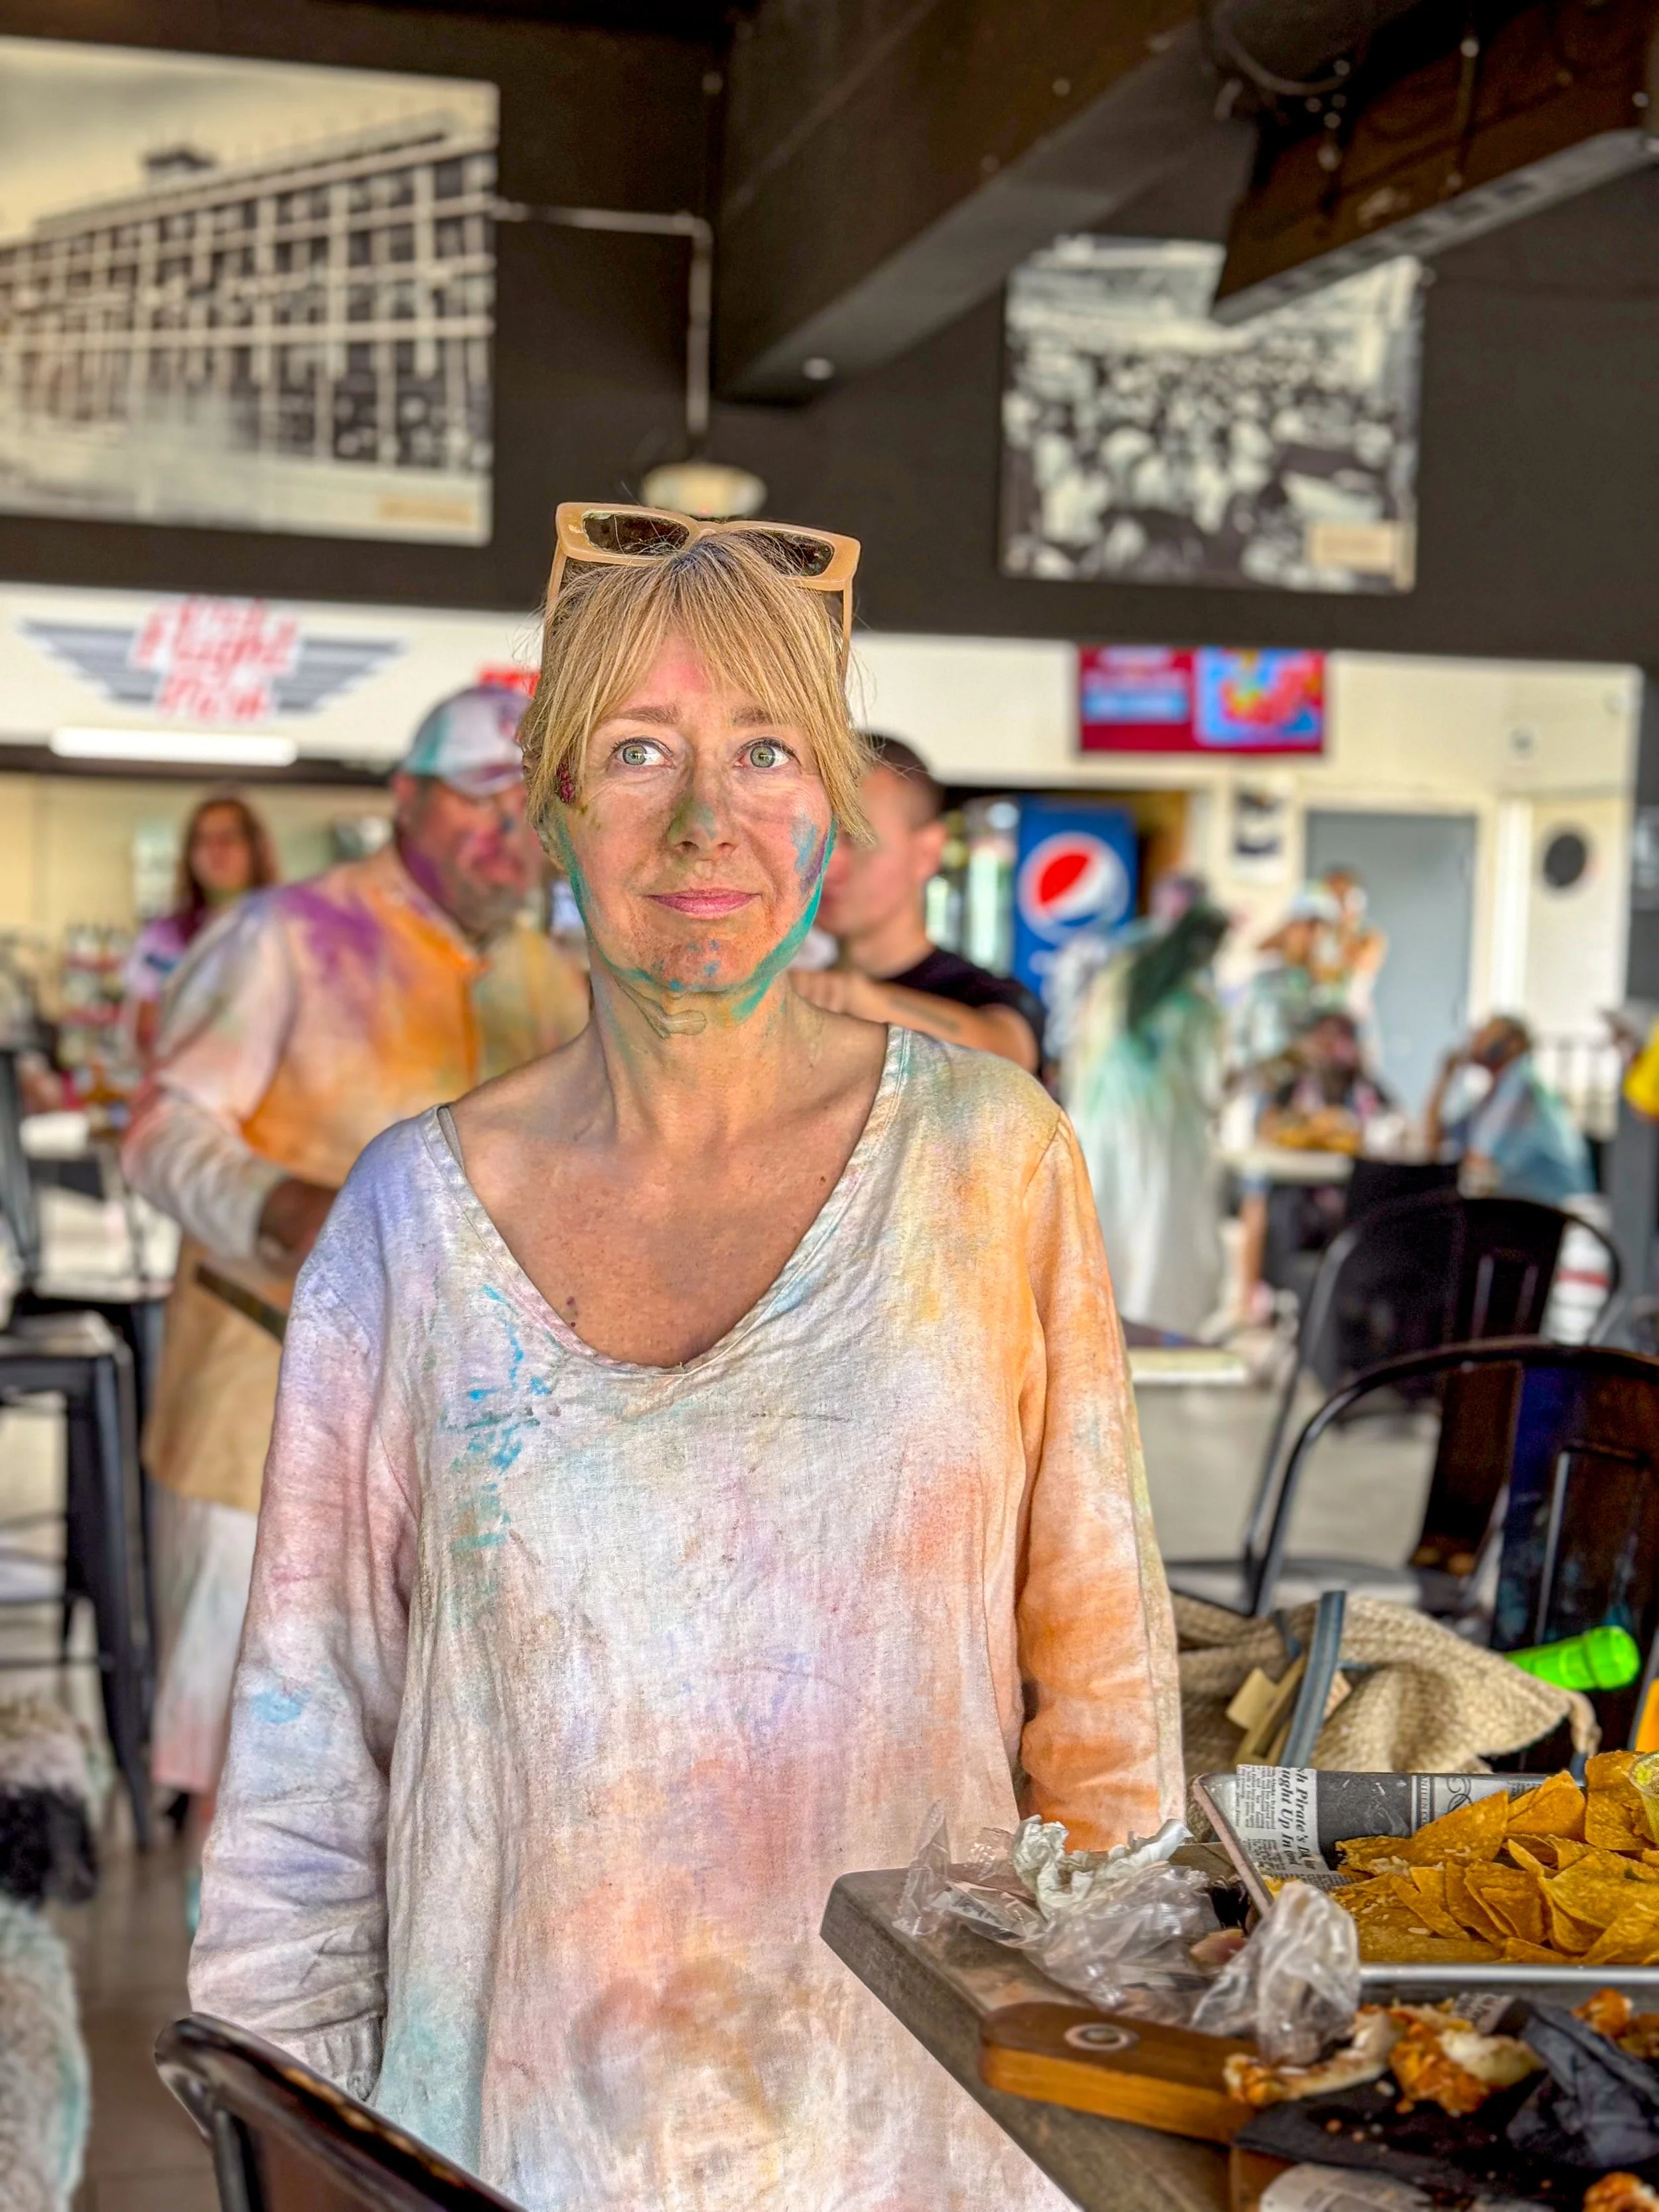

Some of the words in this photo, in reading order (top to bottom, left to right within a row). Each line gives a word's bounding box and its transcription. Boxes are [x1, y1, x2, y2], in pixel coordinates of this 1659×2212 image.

[1277, 1808, 1293, 1829] Up
[1295, 1787, 1309, 1843] Pirate's
[1281, 1833, 1294, 1848] In
